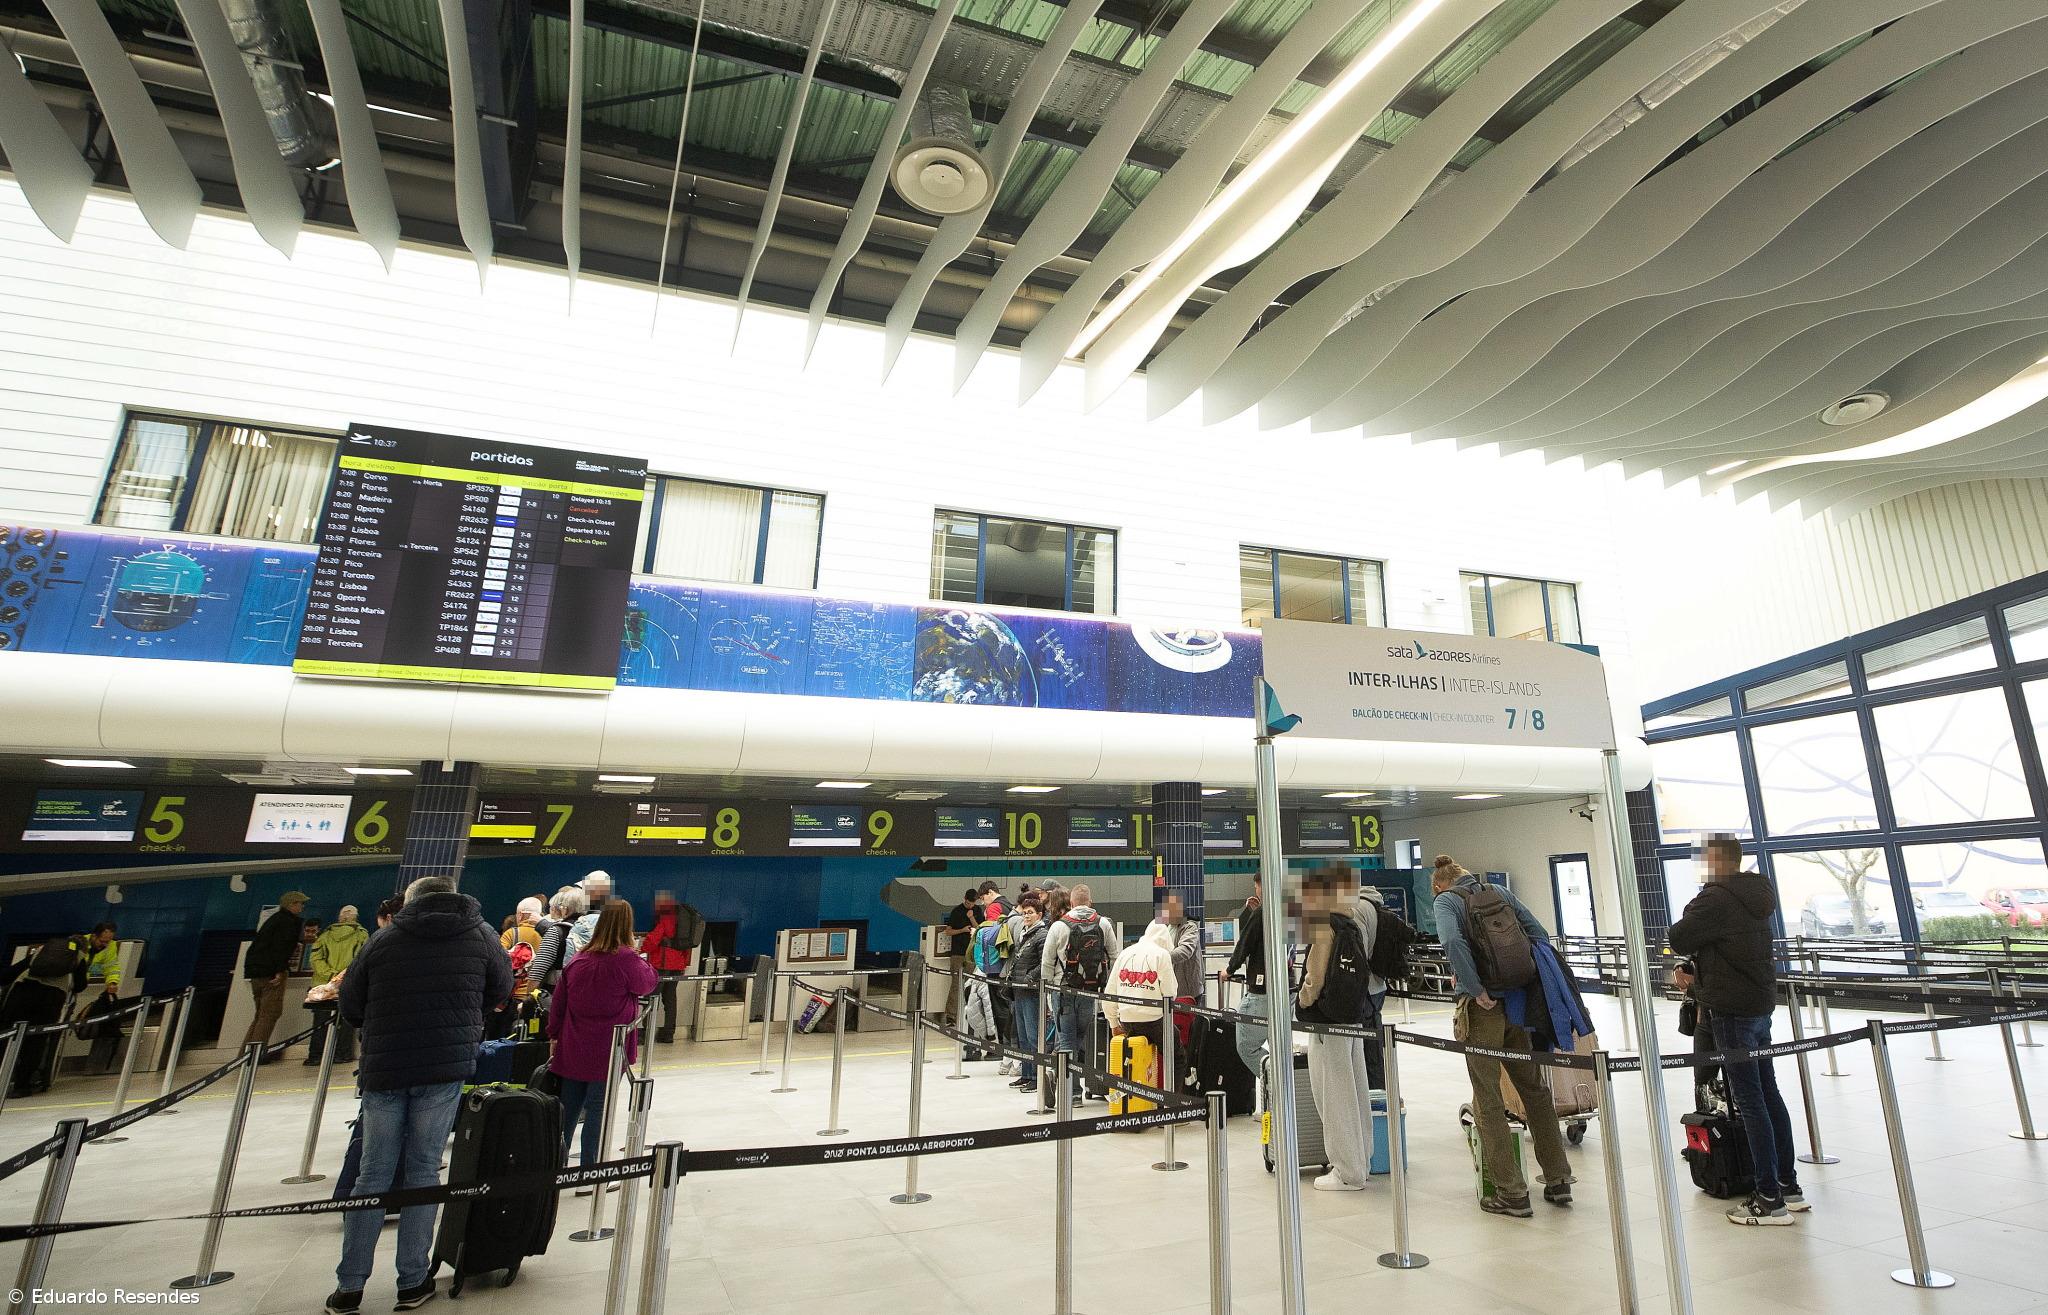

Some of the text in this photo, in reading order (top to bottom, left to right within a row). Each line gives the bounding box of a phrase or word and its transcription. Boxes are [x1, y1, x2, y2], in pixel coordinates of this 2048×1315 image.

[374, 439, 398, 447] 10:37
[470, 451, 534, 466] partidas
[342, 469, 357, 477] 7:00
[363, 473, 389, 482] Corvo
[423, 479, 443, 487] Horta
[466, 484, 495, 493] SP3576
[571, 496, 595, 504] Delayed
[362, 483, 388, 492] Flores
[464, 494, 489, 503] SP500
[332, 501, 352, 510] 10:00
[357, 504, 385, 514] Oporto
[460, 515, 490, 525] FR2632
[566, 526, 594, 535] Departed
[359, 494, 393, 504] Madeira
[462, 505, 486, 514] S4160
[568, 516, 594, 525] Check-in
[596, 519, 615, 527] Closed
[328, 523, 348, 531] 13:35
[352, 526, 380, 536] Lisboa
[456, 536, 480, 545] S4124
[330, 512, 350, 520] 12:00
[354, 515, 379, 524] Horta
[458, 526, 487, 535] SP1444
[564, 536, 591, 545] Check-in
[349, 537, 377, 546] Flores
[410, 543, 438, 552] Terceira
[454, 547, 480, 556] SP542
[347, 548, 382, 558] Terceira
[451, 558, 477, 567] SP406
[344, 560, 364, 568] Pico
[449, 569, 479, 578] SP1434
[342, 571, 376, 580] Toronto
[447, 580, 473, 589] S4363
[339, 582, 368, 591] Lisboa
[445, 590, 475, 600] FR2622
[337, 594, 367, 602] Oporto
[443, 602, 468, 610] S4174
[334, 605, 359, 613] Santa
[361, 607, 386, 615] Maria
[441, 612, 468, 622] SP107
[332, 616, 361, 625] Lisboa
[439, 624, 469, 632] TP1864
[301, 636, 322, 644] 20:05
[327, 639, 364, 648] Terceira
[435, 646, 461, 655] SP408
[329, 628, 358, 636] Lisboa
[436, 635, 462, 644] S4128
[1387, 644, 1501, 666] sata Airlines
[1348, 671, 1542, 697] INTER-ILHAS INTER-ISLANDS
[1352, 706, 1382, 720] BALCÃO
[1384, 710, 1394, 720] DE
[1395, 710, 1429, 721] CHECK-IN
[1505, 708, 1517, 730] 7
[1532, 709, 1546, 731] 8
[145, 796, 186, 844] 5
[354, 801, 389, 845] 6
[543, 805, 574, 846] 7
[713, 808, 740, 848] 8
[868, 810, 894, 848] 9
[1005, 812, 1042, 849] 10
[1351, 815, 1381, 848] 13
[139, 844, 186, 853] check-in
[350, 844, 391, 854] check-in
[1759, 1048, 1773, 1056] PONTA
[1774, 1046, 1792, 1054] DELGADA
[1115, 1108, 1207, 1128] PONTA DELGADA AEROPO
[846, 1146, 877, 1157] PONTA
[880, 1142, 921, 1154] DELGADA
[922, 1138, 975, 1151] AEROPORTO
[583, 1162, 652, 1180] PONTA DELG
[240, 1206, 299, 1215] DELGADA
[302, 1198, 380, 1212] AEROPORTO
